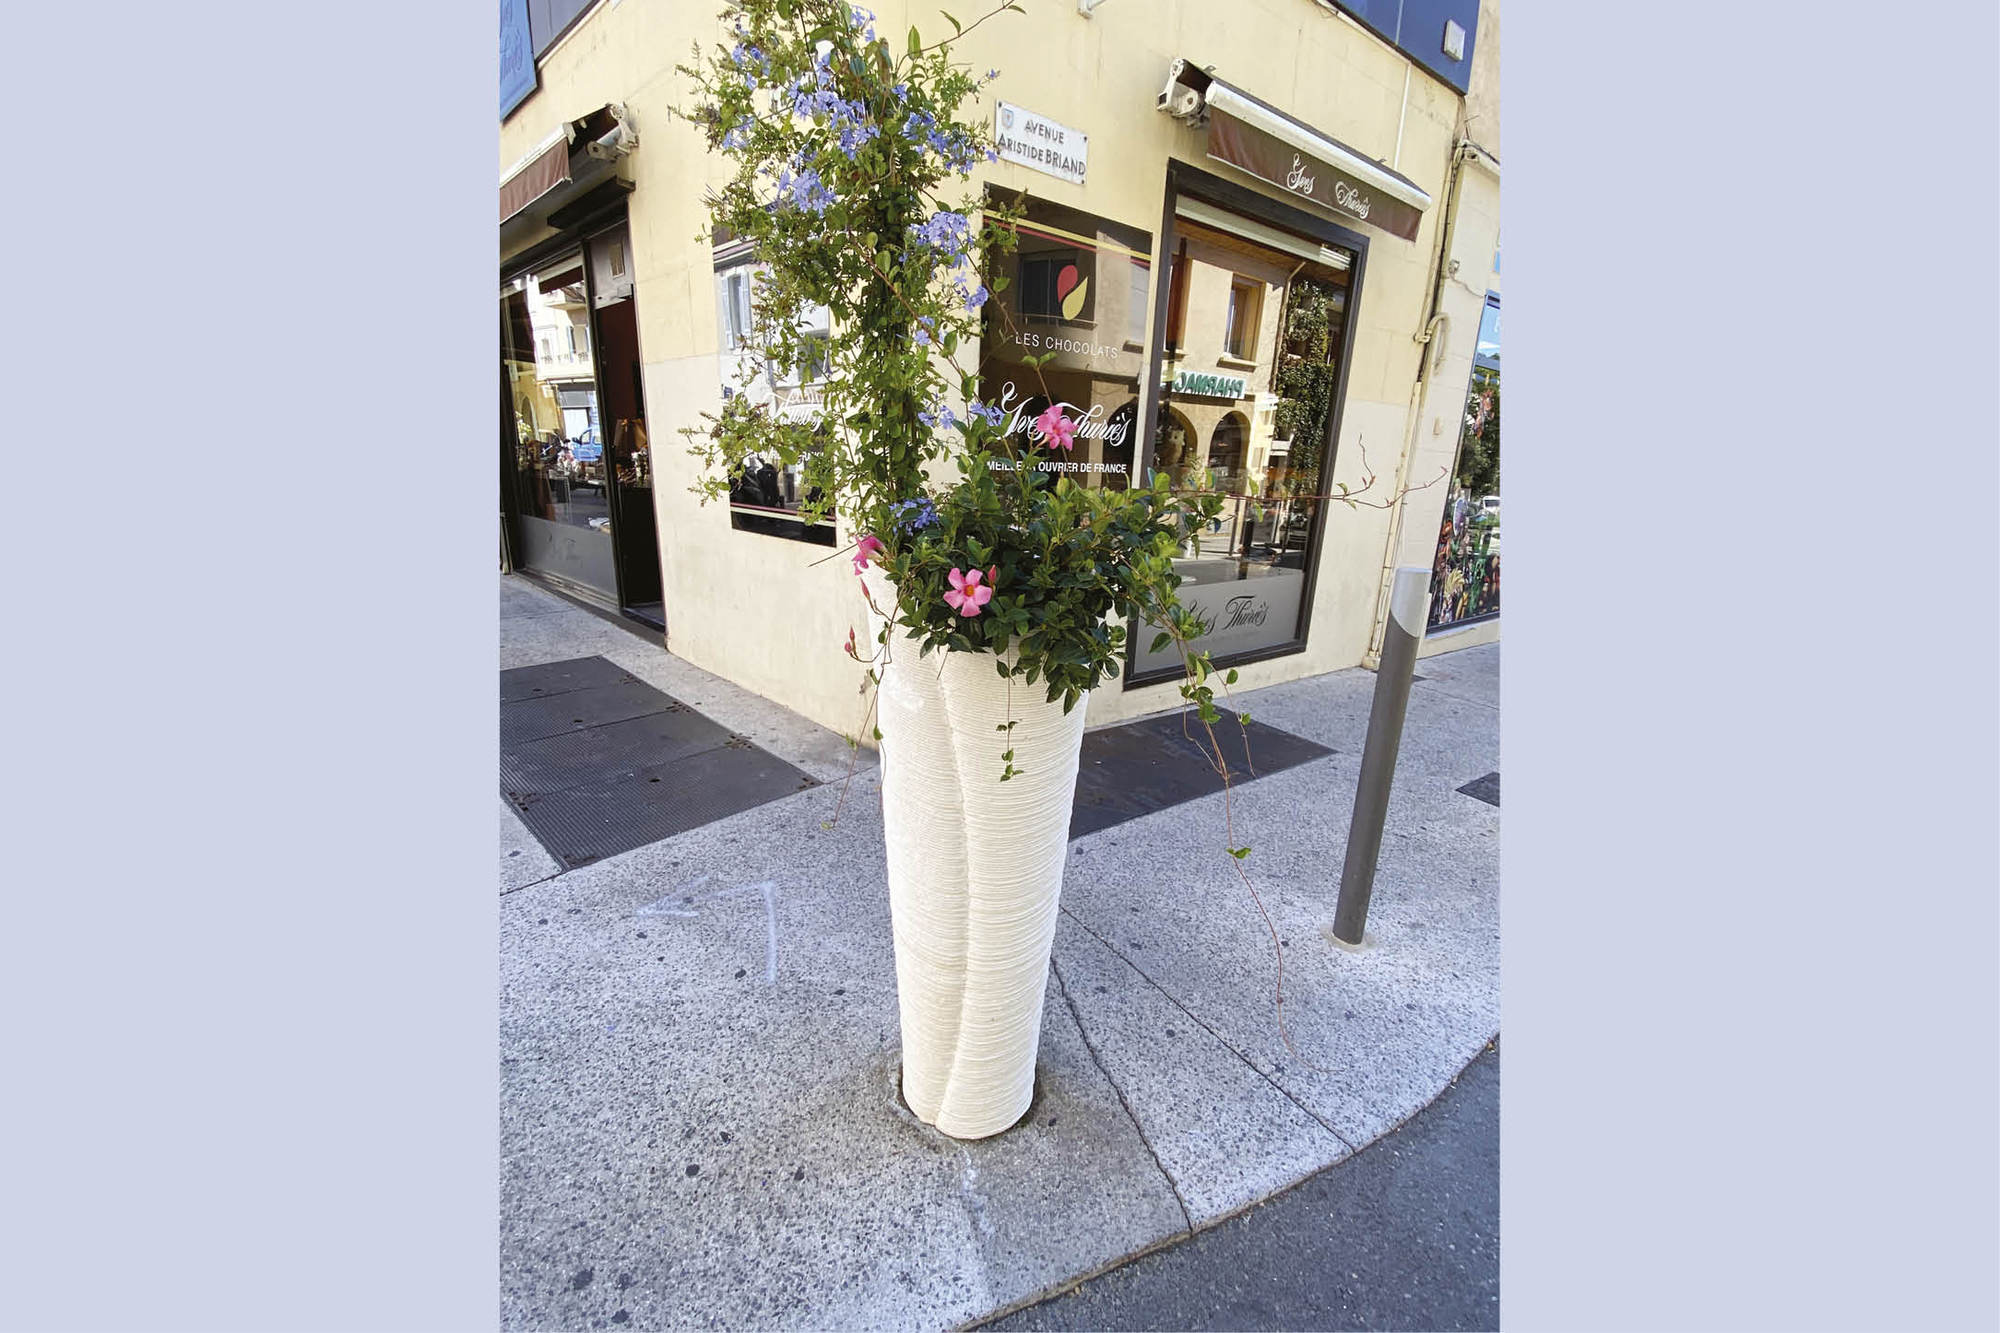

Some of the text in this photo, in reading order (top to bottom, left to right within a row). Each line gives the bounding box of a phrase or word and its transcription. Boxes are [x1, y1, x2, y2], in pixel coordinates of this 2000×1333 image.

[1024, 123, 1065, 145] AVENUE
[998, 134, 1086, 176] ARISTIDE BRIAND
[1015, 331, 1119, 359] LES CHOCOLATS
[1080, 463, 1092, 473] DE
[1093, 463, 1127, 474] FRANCE
